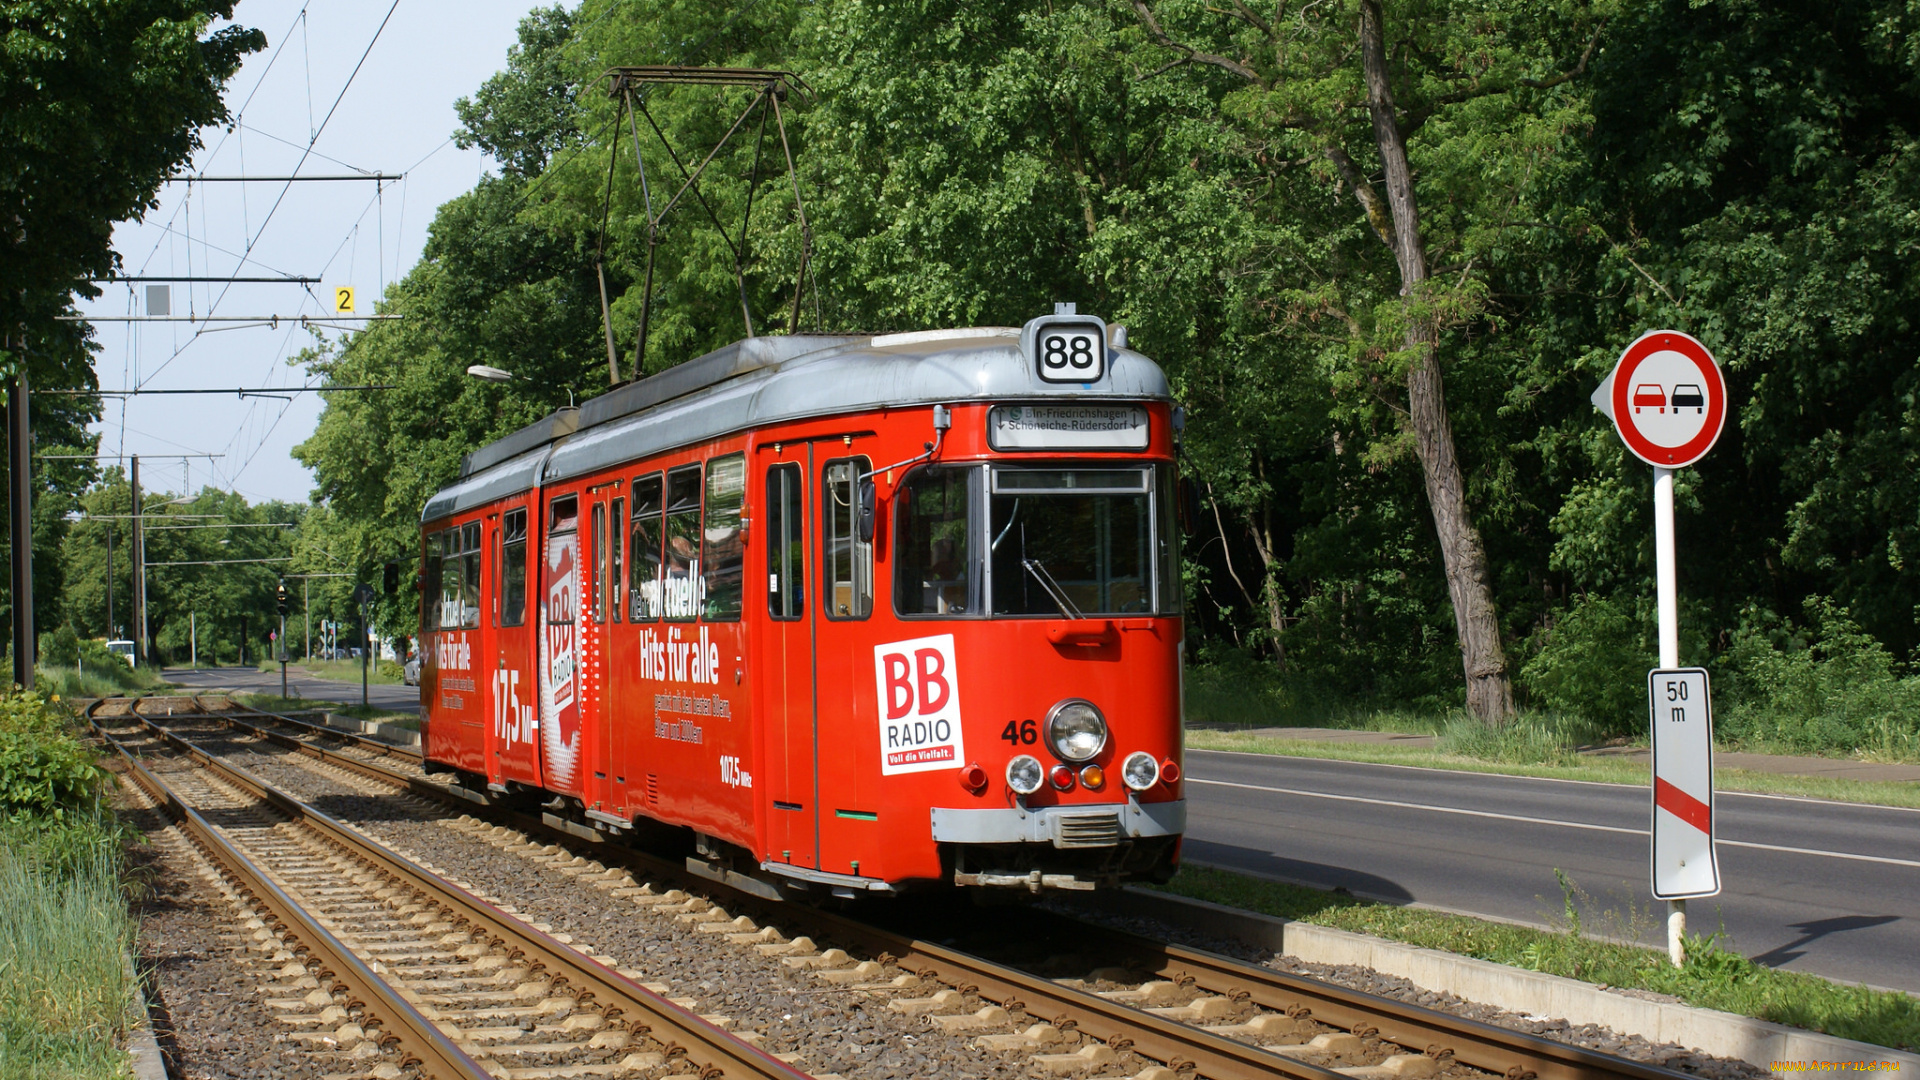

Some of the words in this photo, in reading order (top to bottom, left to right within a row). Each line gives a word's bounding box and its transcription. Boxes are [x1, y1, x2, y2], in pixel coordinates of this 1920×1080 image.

[339, 290, 351, 310] 2
[1045, 336, 1093, 369] 88
[1008, 420, 1128, 431] Schöneiche-Rüdersdorf
[649, 560, 706, 618] aktuelle
[640, 627, 666, 682] Hits
[667, 626, 690, 682] für
[691, 626, 719, 685] alle
[882, 647, 951, 720] BB
[1667, 681, 1688, 701] 50
[1671, 707, 1685, 722] m
[888, 719, 951, 748] RADIO
[1001, 719, 1037, 746] 46
[889, 754, 903, 763] Voll
[905, 752, 917, 762] die
[918, 749, 952, 760] Vielfalt.
[719, 755, 740, 789] 107,5
